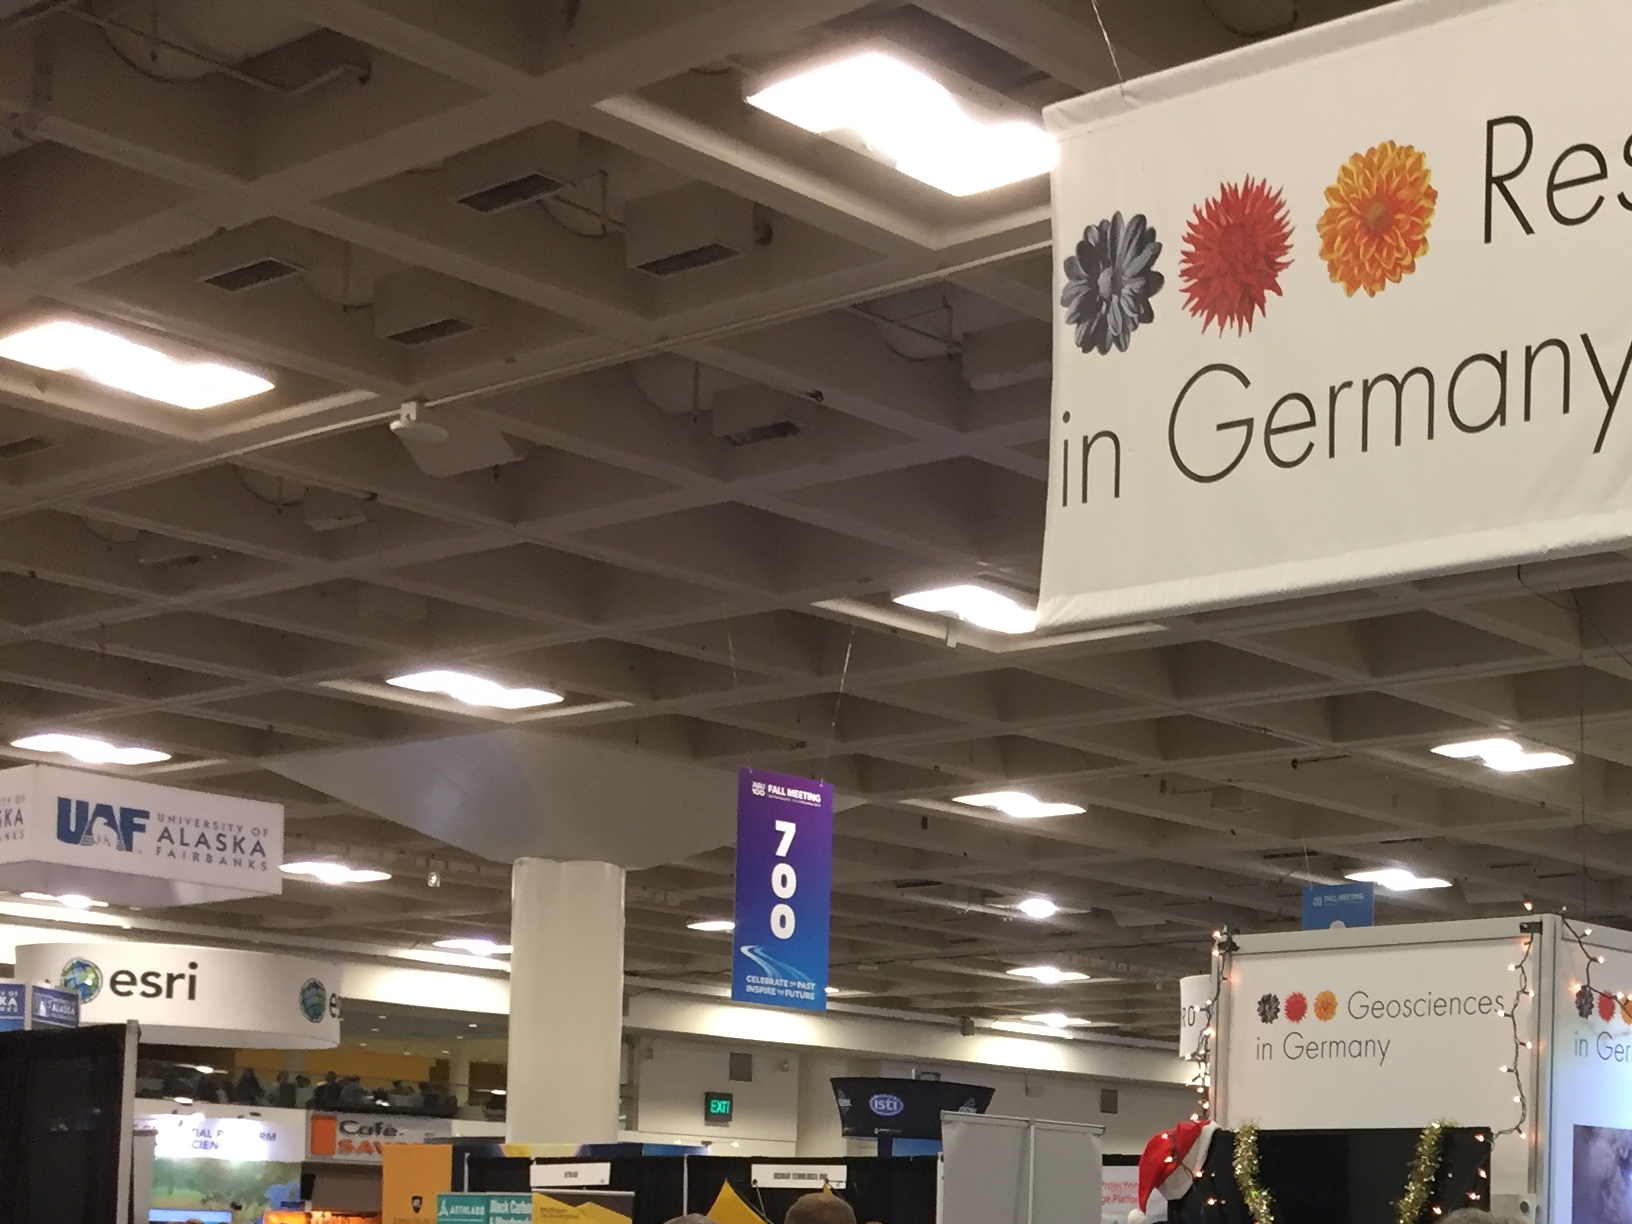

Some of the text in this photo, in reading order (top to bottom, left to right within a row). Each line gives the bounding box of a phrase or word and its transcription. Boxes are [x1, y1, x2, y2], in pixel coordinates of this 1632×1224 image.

[1059, 412, 1122, 506] in
[767, 784, 786, 796] FALL
[787, 788, 821, 803] MEETING
[57, 796, 150, 852] UAF
[157, 812, 269, 838] UNIVERSITY OF
[157, 826, 267, 858] ALASKA
[155, 846, 268, 872] FAIRBANKS
[770, 819, 797, 940] 700
[110, 961, 198, 1000] esri
[746, 974, 788, 988] CELEBRATE
[746, 984, 776, 996] INSPIRE
[1348, 990, 1504, 1020] Geosciences
[1257, 1031, 1391, 1067] in Germany
[1574, 1031, 1588, 1057] in
[710, 1099, 730, 1115] EXIT
